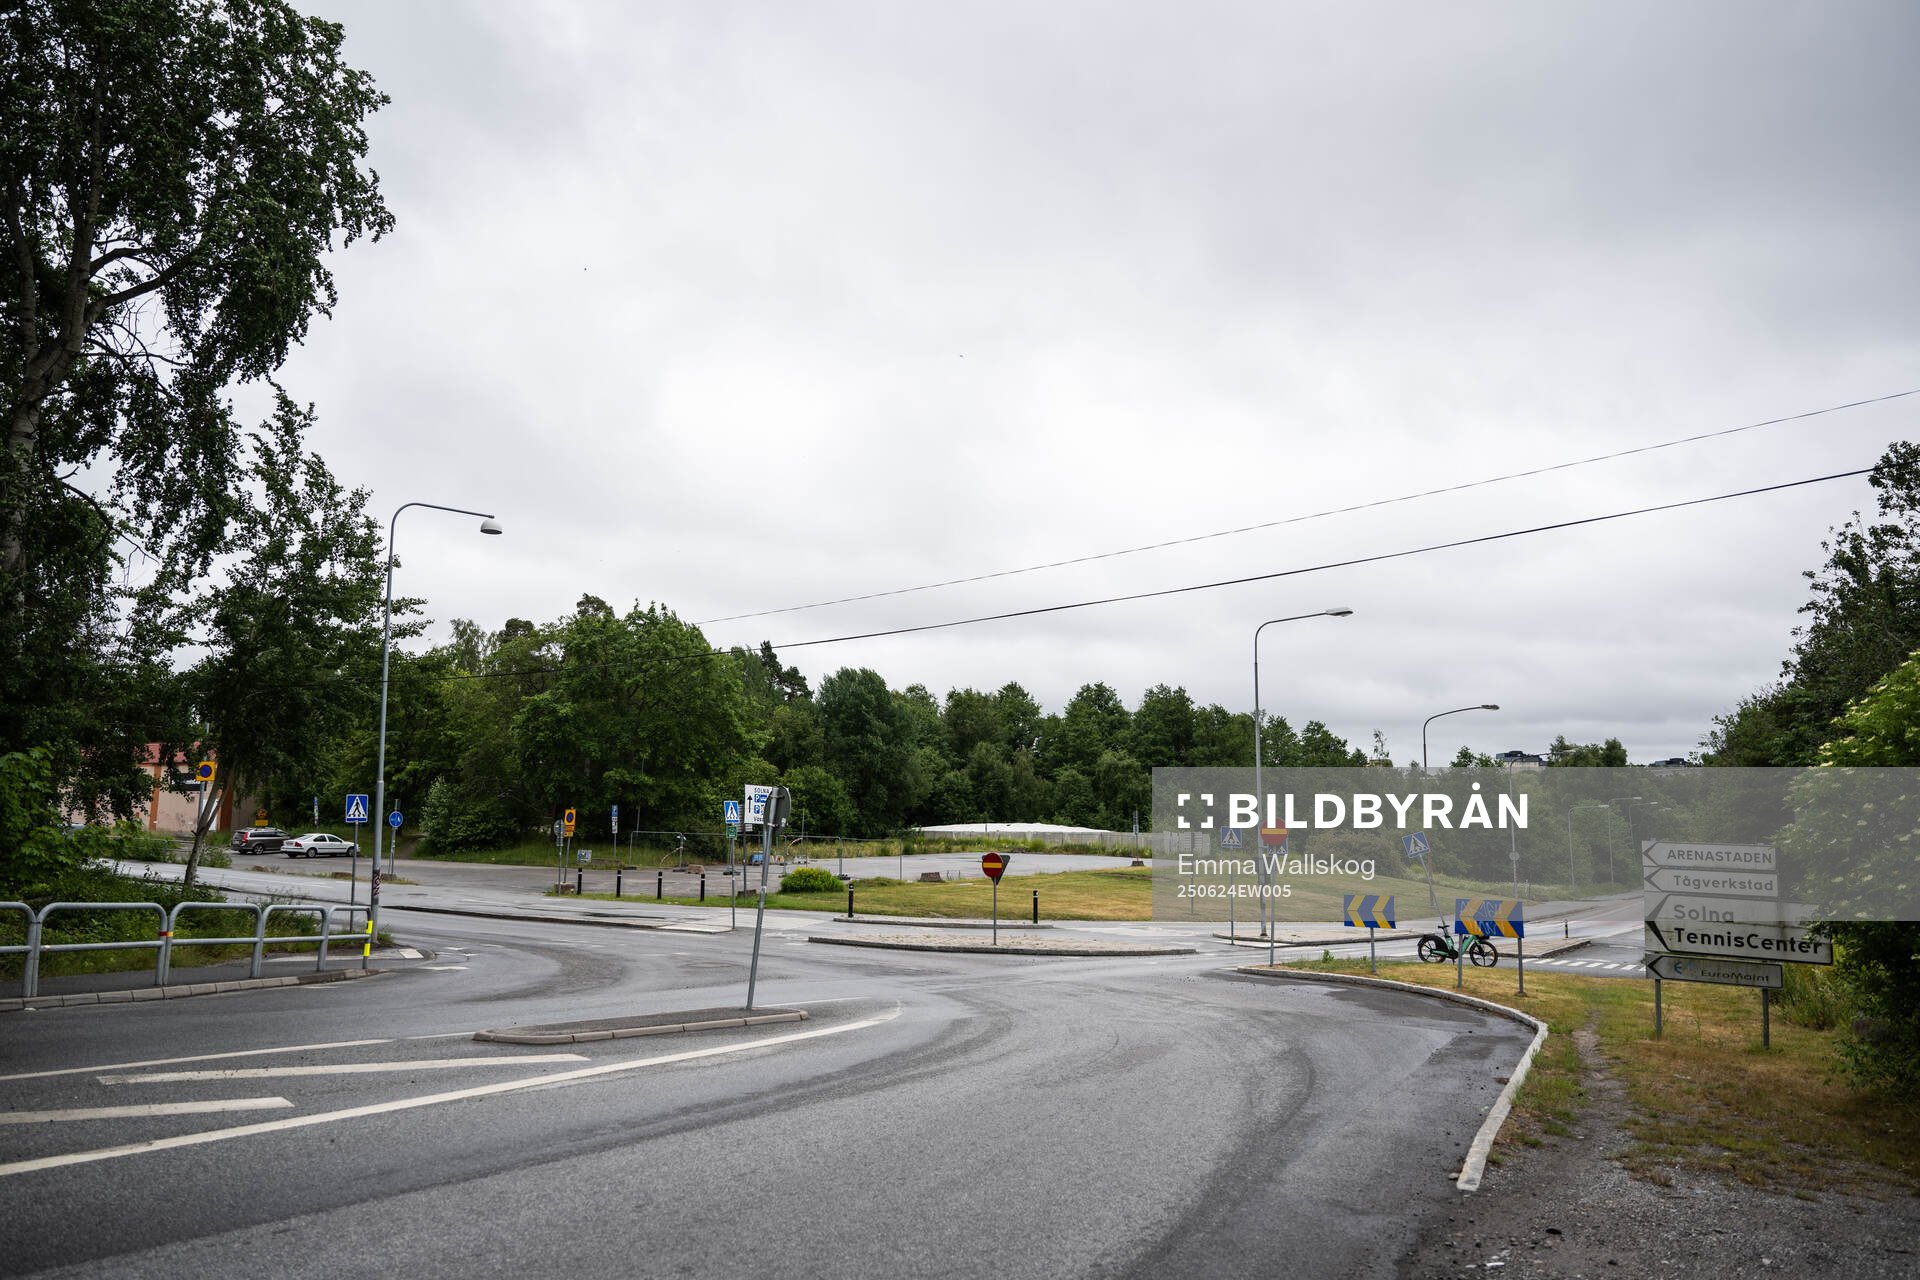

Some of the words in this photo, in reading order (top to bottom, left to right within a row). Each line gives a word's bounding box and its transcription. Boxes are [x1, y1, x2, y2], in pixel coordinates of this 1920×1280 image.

[1667, 849, 1772, 864] ARENASTADEN
[1674, 875, 1774, 891] Tågverkstad
[1674, 904, 1734, 923] Solna
[1674, 927, 1822, 955] TennisCenter
